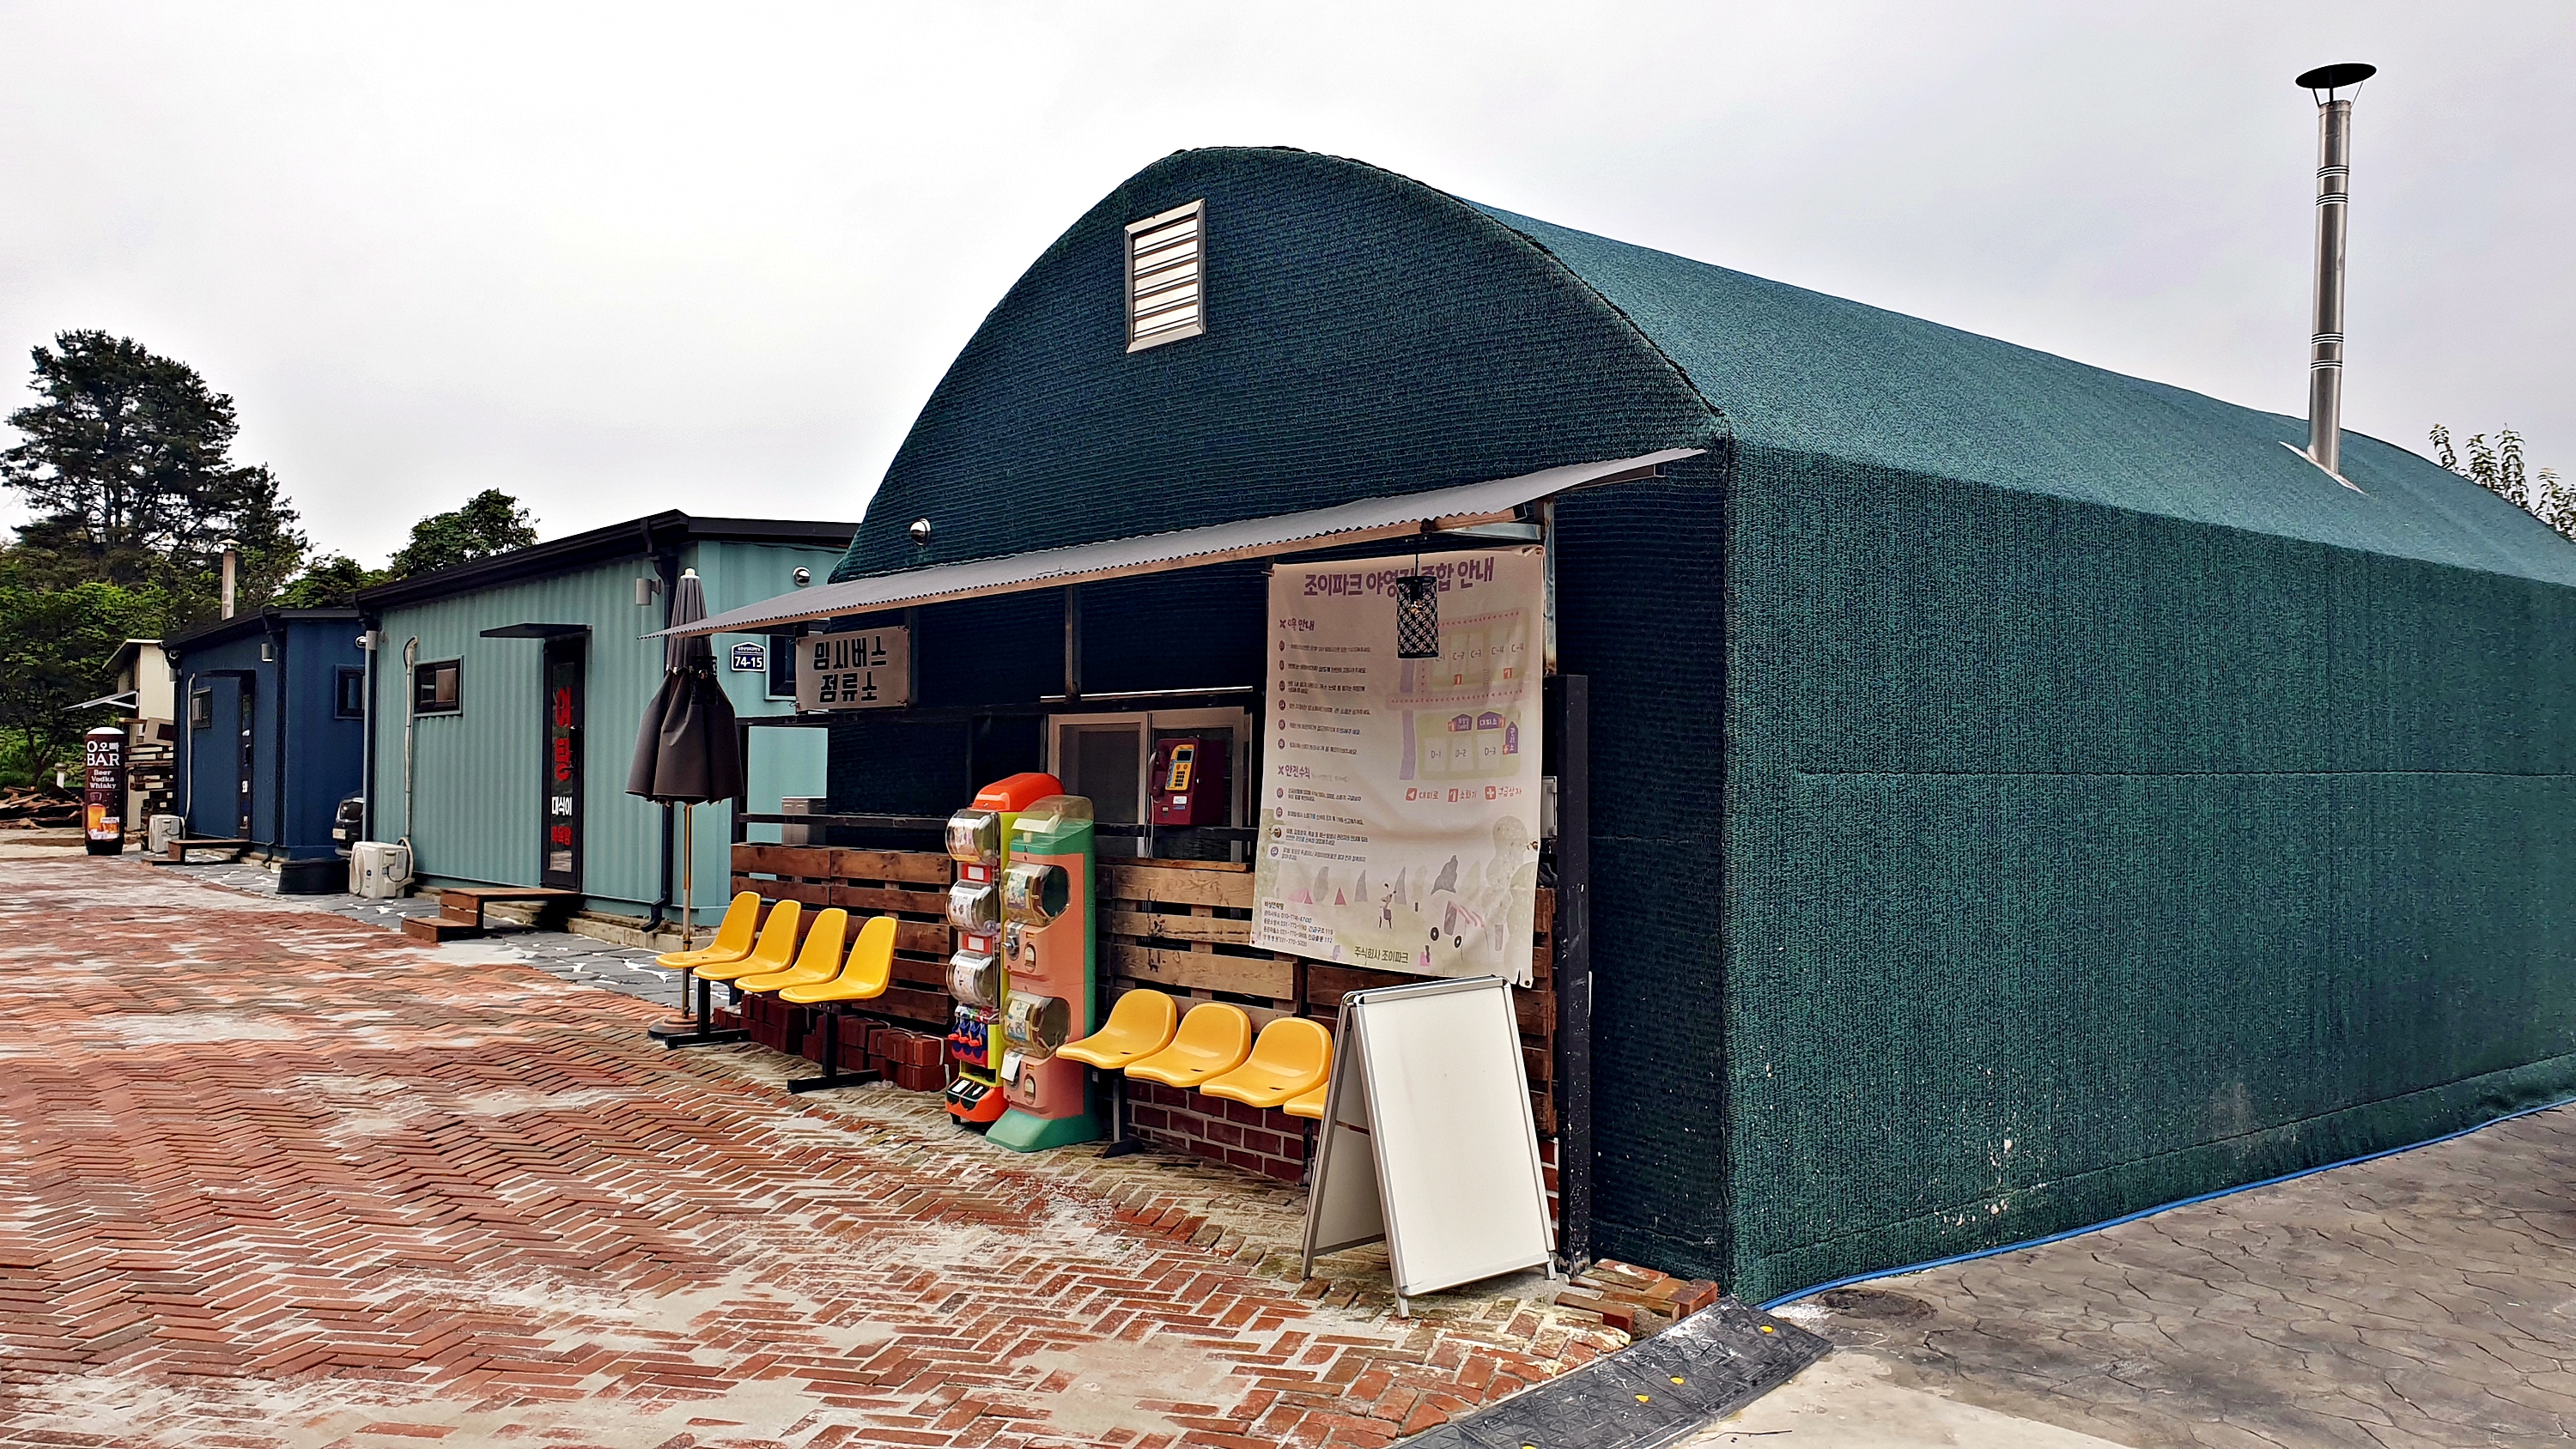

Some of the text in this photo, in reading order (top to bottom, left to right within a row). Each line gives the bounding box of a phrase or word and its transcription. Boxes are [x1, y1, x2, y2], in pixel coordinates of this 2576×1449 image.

[1303, 573, 1364, 597] 조이파크
[1457, 556, 1494, 589] 안내
[1297, 619, 1315, 632] 안내
[813, 635, 887, 670] 임시버스
[734, 656, 762, 668] 74-15
[819, 671, 878, 703] 정류소
[87, 753, 120, 767] BAR
[1419, 791, 1438, 800] 대피로
[1460, 789, 1477, 799] 소화기
[1354, 946, 1409, 963] 주식회사 조이파크
